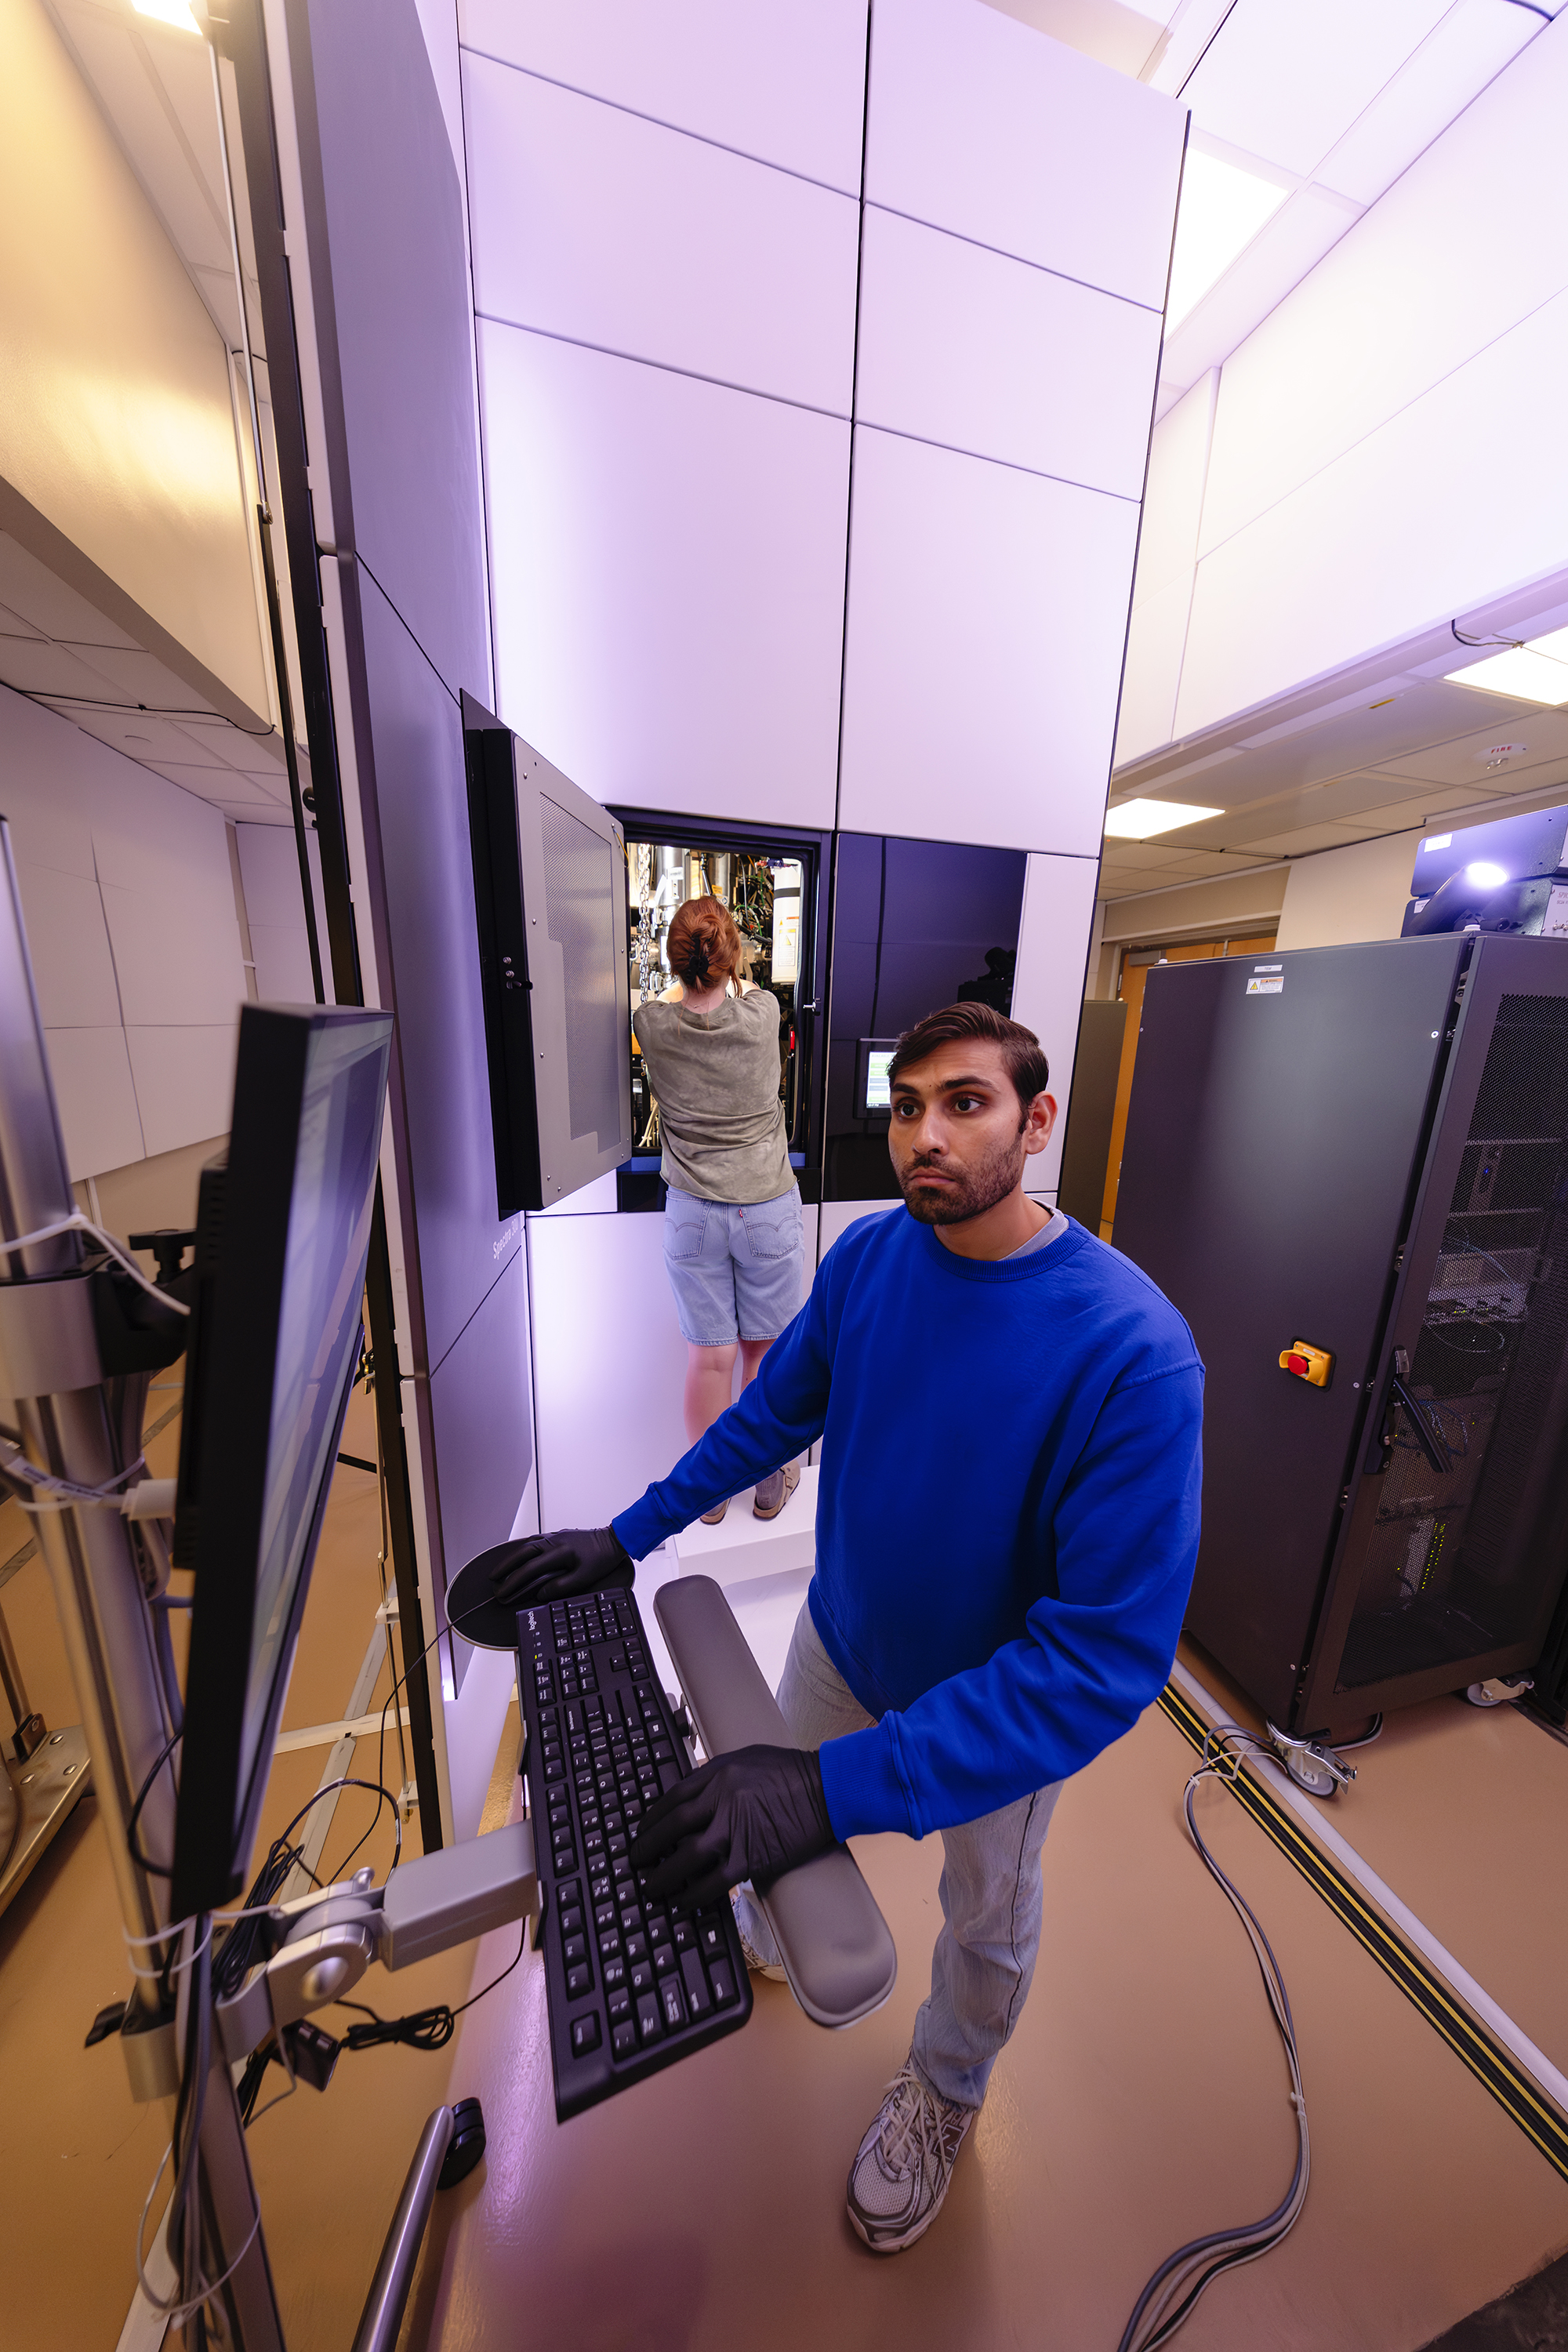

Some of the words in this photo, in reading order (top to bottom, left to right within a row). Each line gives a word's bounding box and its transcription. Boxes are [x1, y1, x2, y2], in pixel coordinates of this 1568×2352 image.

[493, 1229, 511, 1260] Spectra
[528, 1611, 537, 1631] logitech
[619, 1891, 626, 1900] R
[624, 1918, 631, 1927] E
[652, 1929, 658, 1937] S
[677, 1932, 684, 1941] Z
